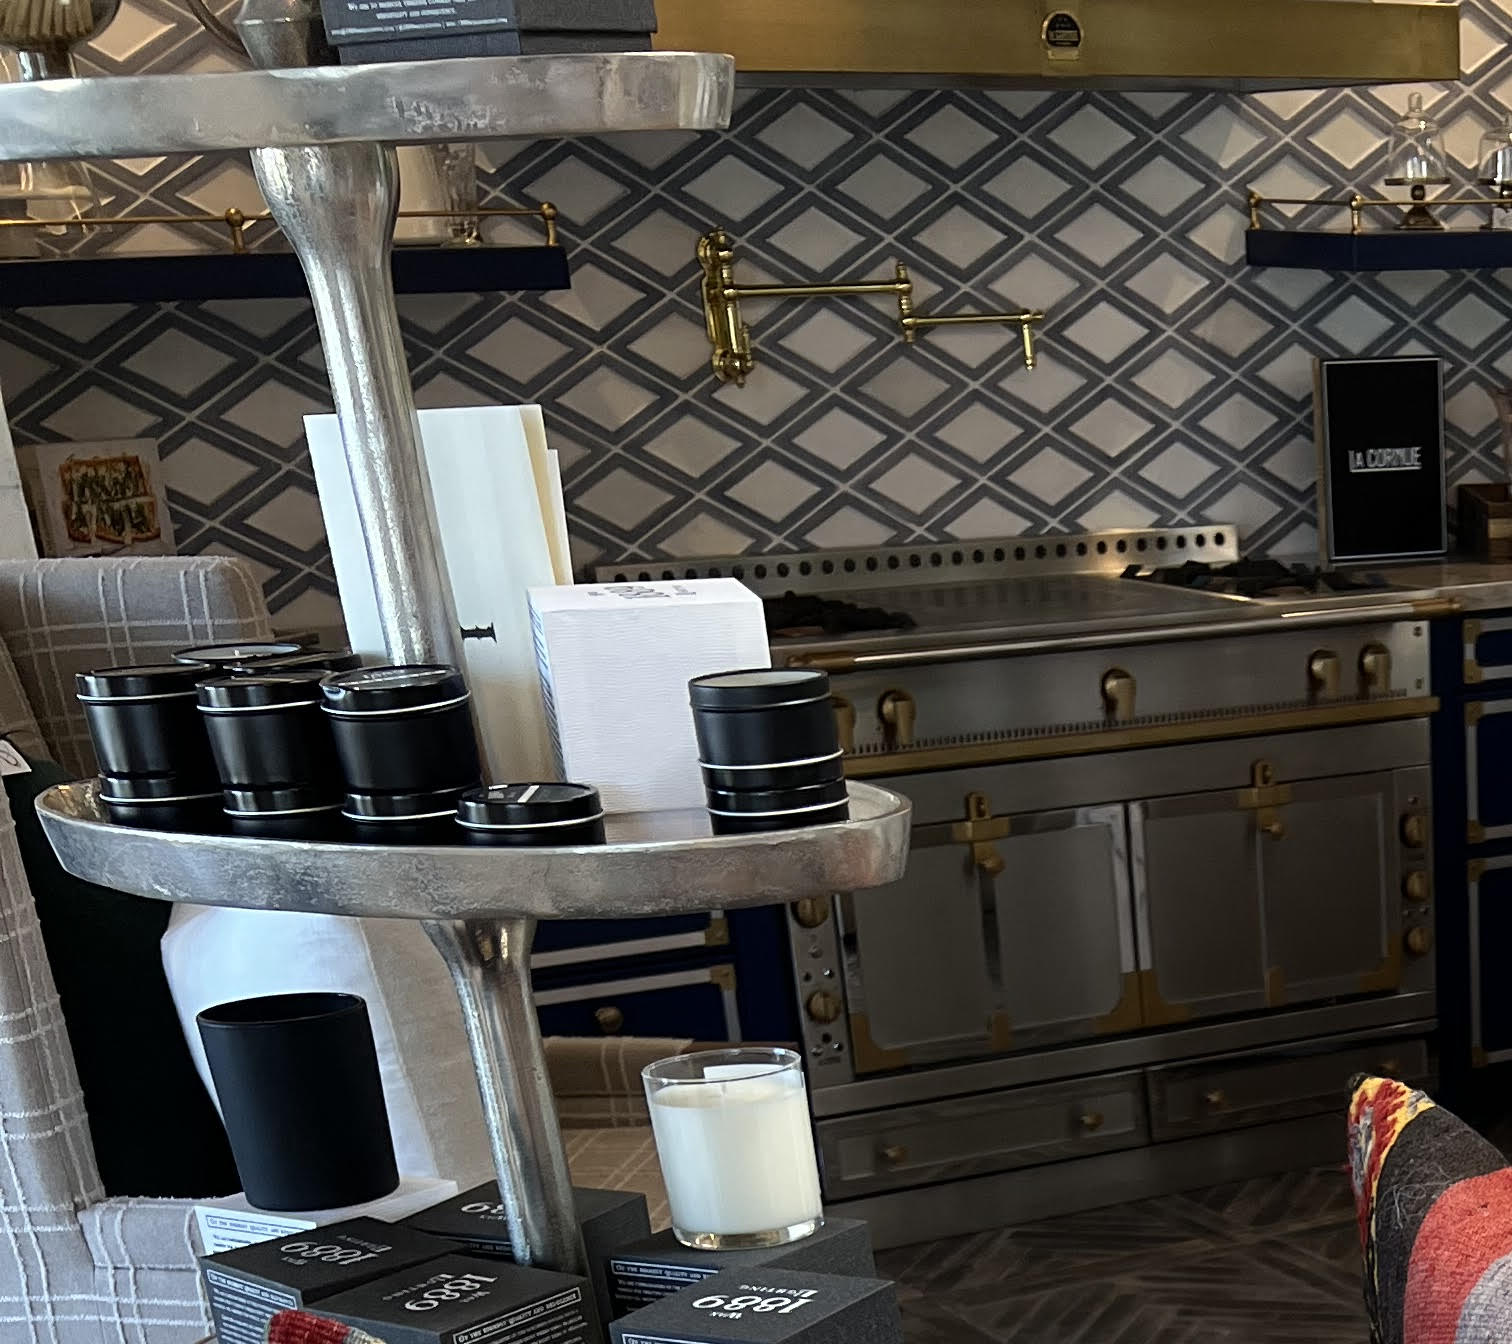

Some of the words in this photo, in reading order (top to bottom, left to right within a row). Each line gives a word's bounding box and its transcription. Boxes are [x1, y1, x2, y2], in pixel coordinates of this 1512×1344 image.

[280, 1241, 379, 1265] 1889
[404, 1273, 499, 1311] 1889
[692, 1295, 814, 1314] 1889
